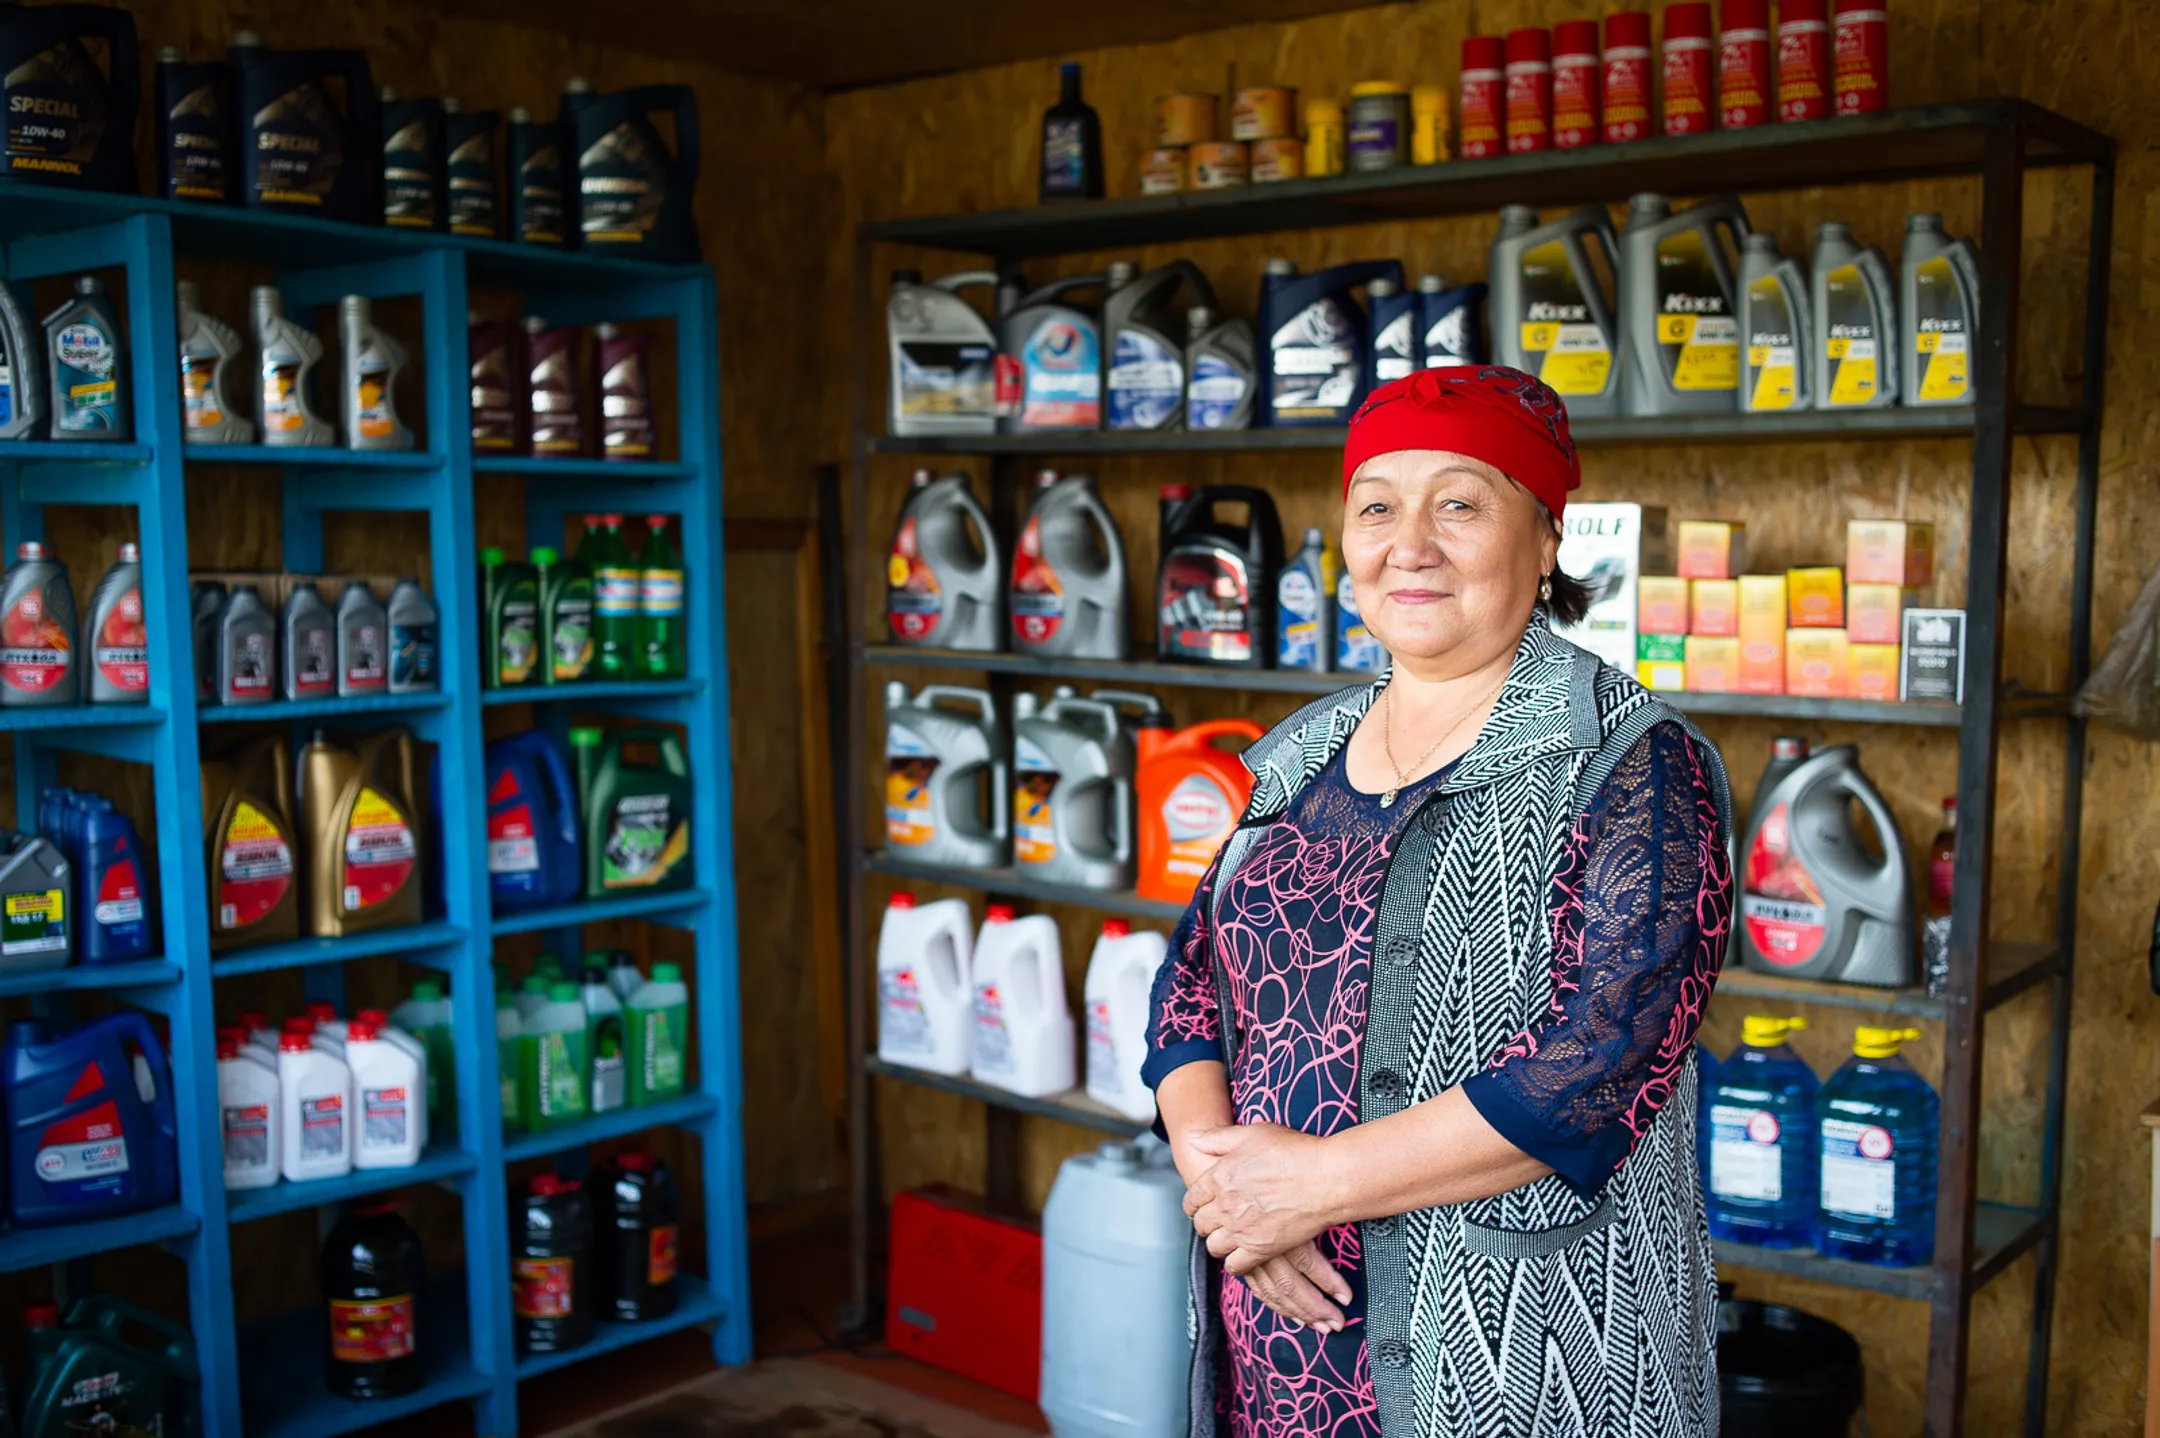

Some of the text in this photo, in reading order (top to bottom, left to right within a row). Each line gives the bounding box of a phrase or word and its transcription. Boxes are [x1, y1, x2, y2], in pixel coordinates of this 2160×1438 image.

[9, 96, 80, 118] SPECIAL
[21, 125, 67, 140] 10W-40
[12, 156, 83, 176] MANNOL
[1528, 302, 1588, 321] Kixx
[1664, 294, 1723, 313] Kixx
[62, 334, 100, 347] Mobil
